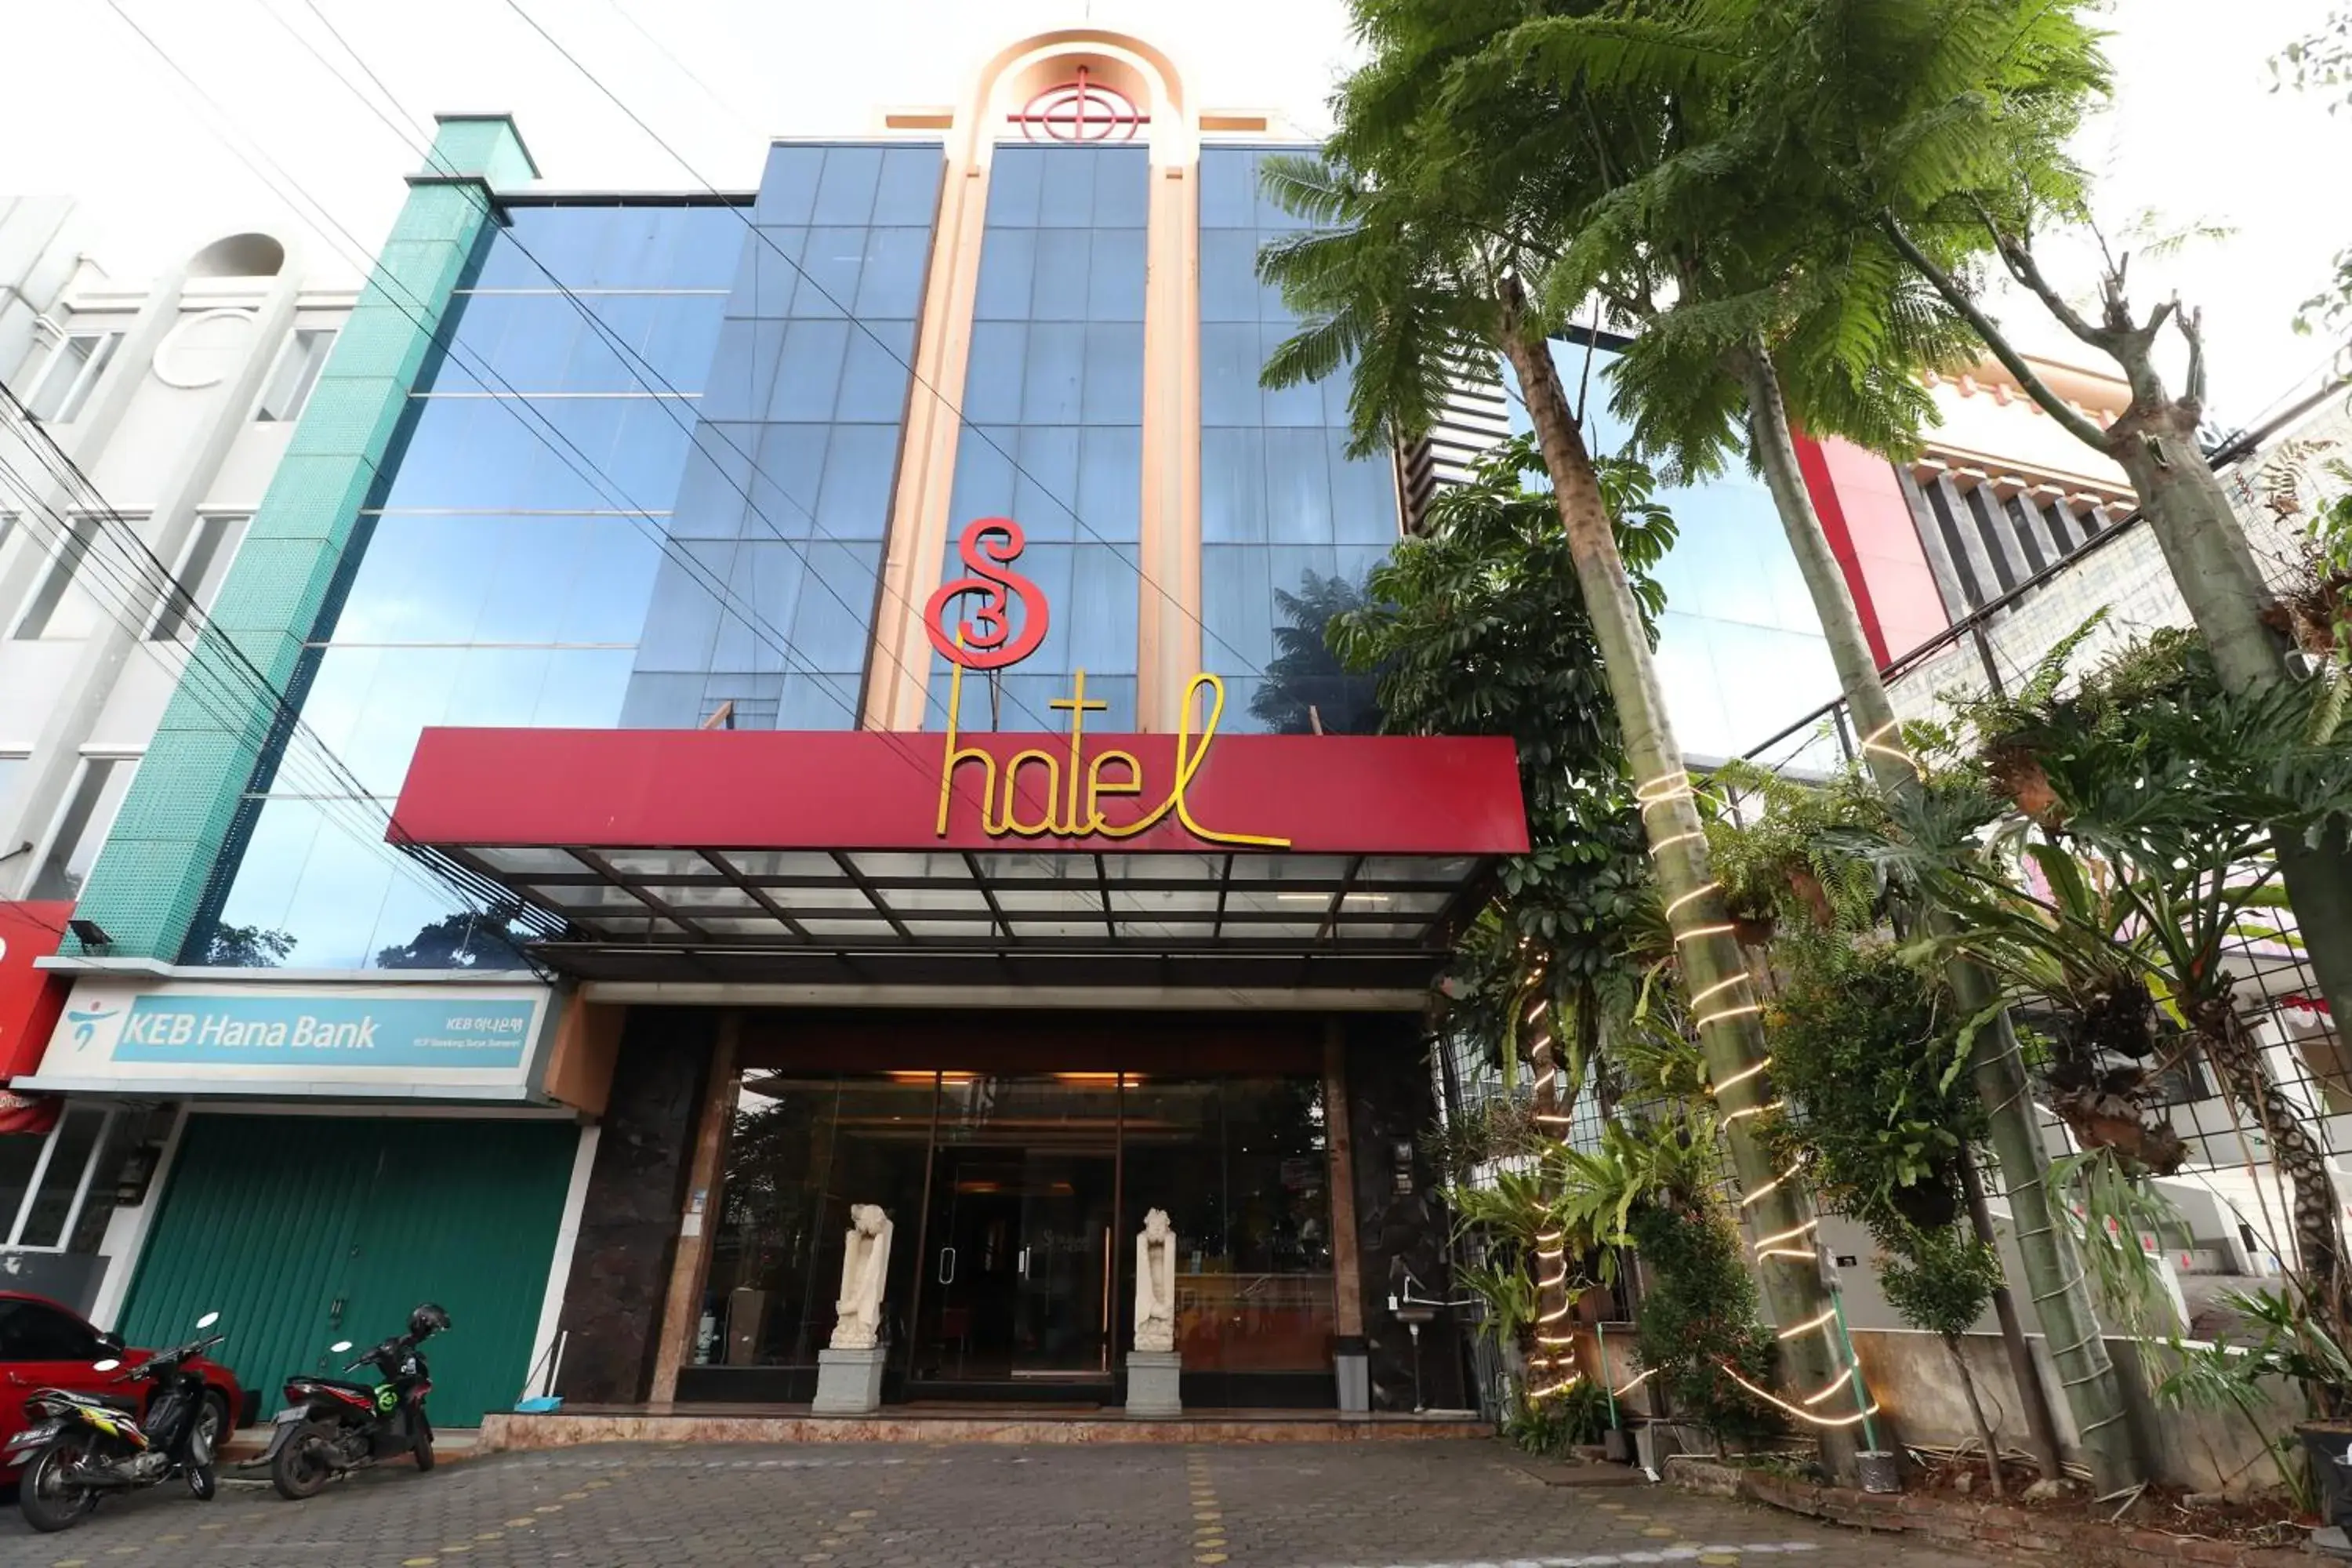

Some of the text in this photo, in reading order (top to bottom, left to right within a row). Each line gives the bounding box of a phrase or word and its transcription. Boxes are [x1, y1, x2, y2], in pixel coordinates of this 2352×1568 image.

[123, 1012, 382, 1049] KEB Hana Bank
[446, 1016, 472, 1030] KEB
